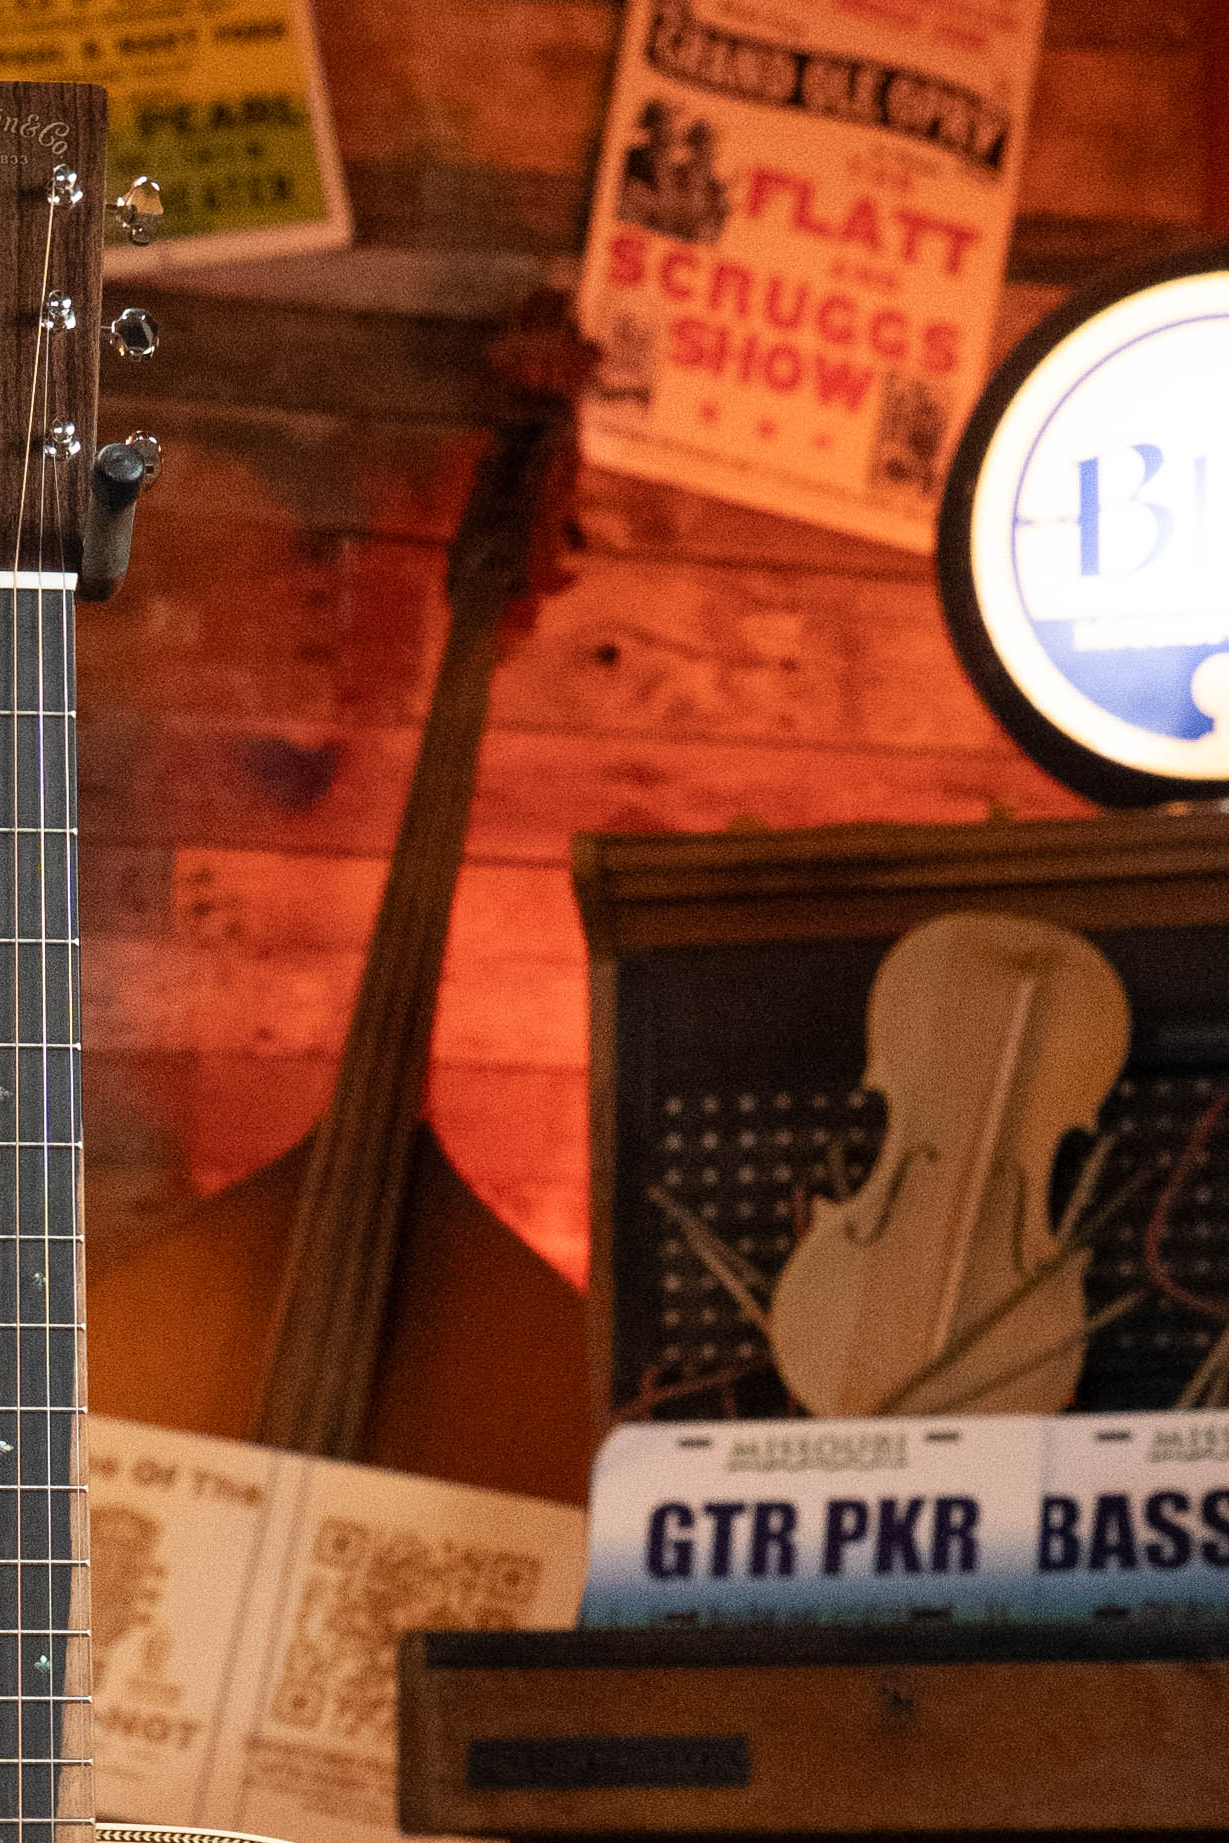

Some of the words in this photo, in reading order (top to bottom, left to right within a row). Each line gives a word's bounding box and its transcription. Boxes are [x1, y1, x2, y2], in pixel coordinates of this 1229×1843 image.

[745, 161, 984, 276] FLATT
[608, 231, 962, 375] SCRUGGS
[671, 314, 872, 414] SHOW
[645, 1502, 800, 1578] GTR
[823, 1494, 978, 1574] PKR
